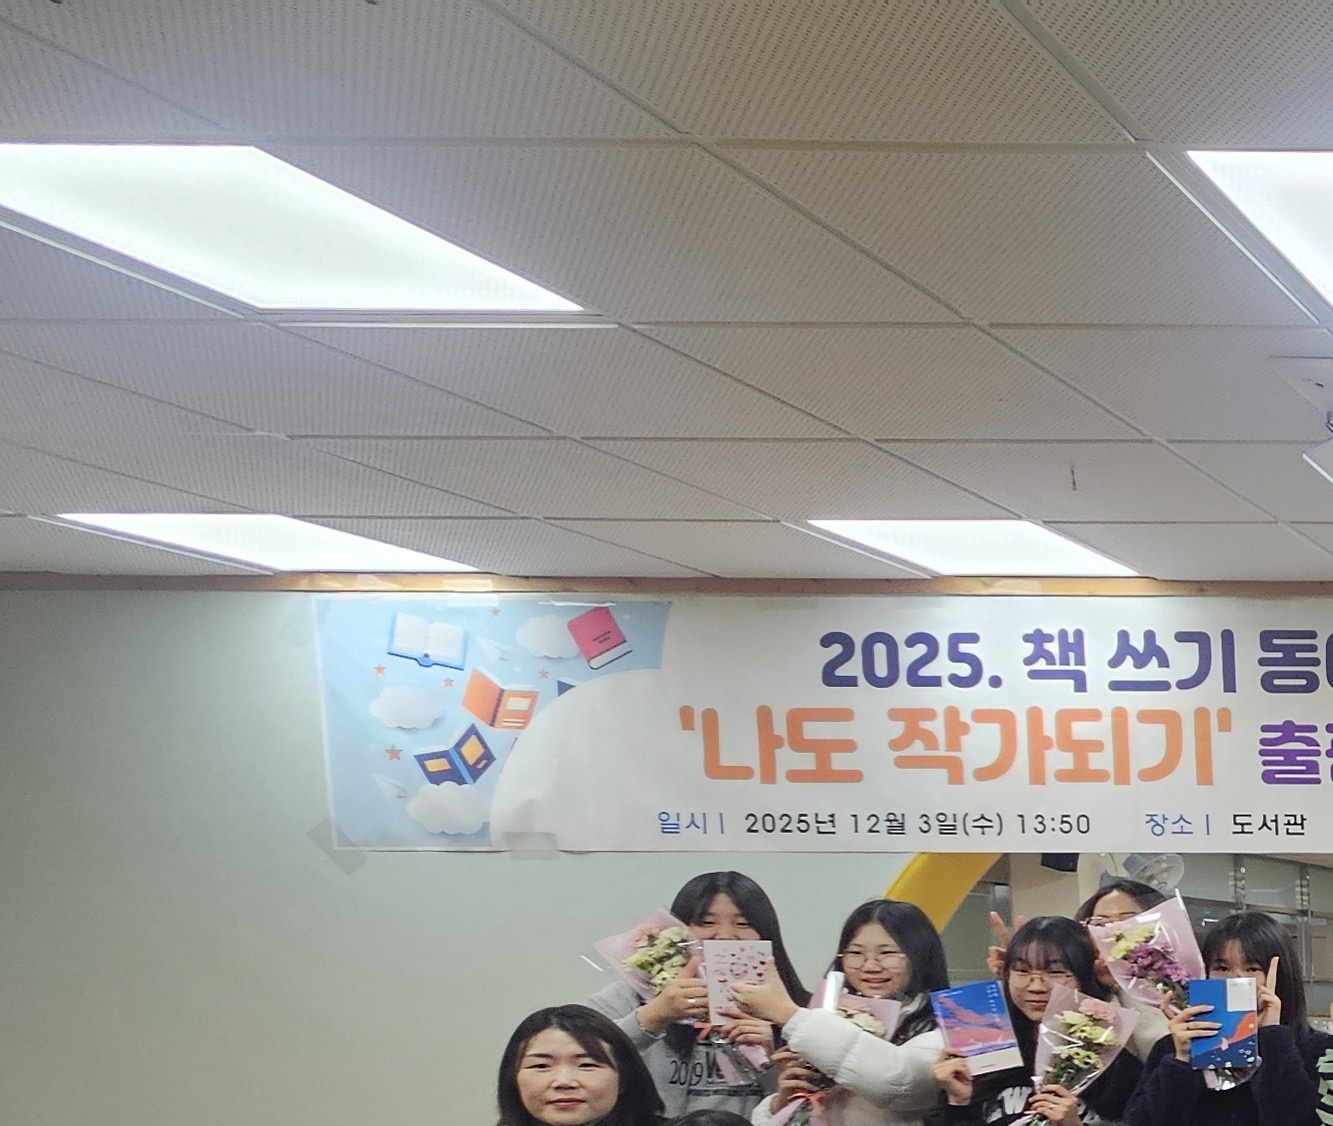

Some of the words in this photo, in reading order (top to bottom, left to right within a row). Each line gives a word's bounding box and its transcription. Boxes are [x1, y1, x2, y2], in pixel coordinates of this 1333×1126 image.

[819, 630, 1003, 688] 2025.
[1022, 628, 1087, 693] 책
[1107, 628, 1237, 693] 쓰기
[679, 705, 865, 785] '나도
[887, 706, 1232, 786] 작가되기'
[744, 812, 838, 836] 2025년
[849, 811, 907, 836] 12월
[918, 811, 1004, 837] 3일(수)
[1017, 812, 1091, 835] 13:50
[1231, 812, 1308, 837] 도서관
